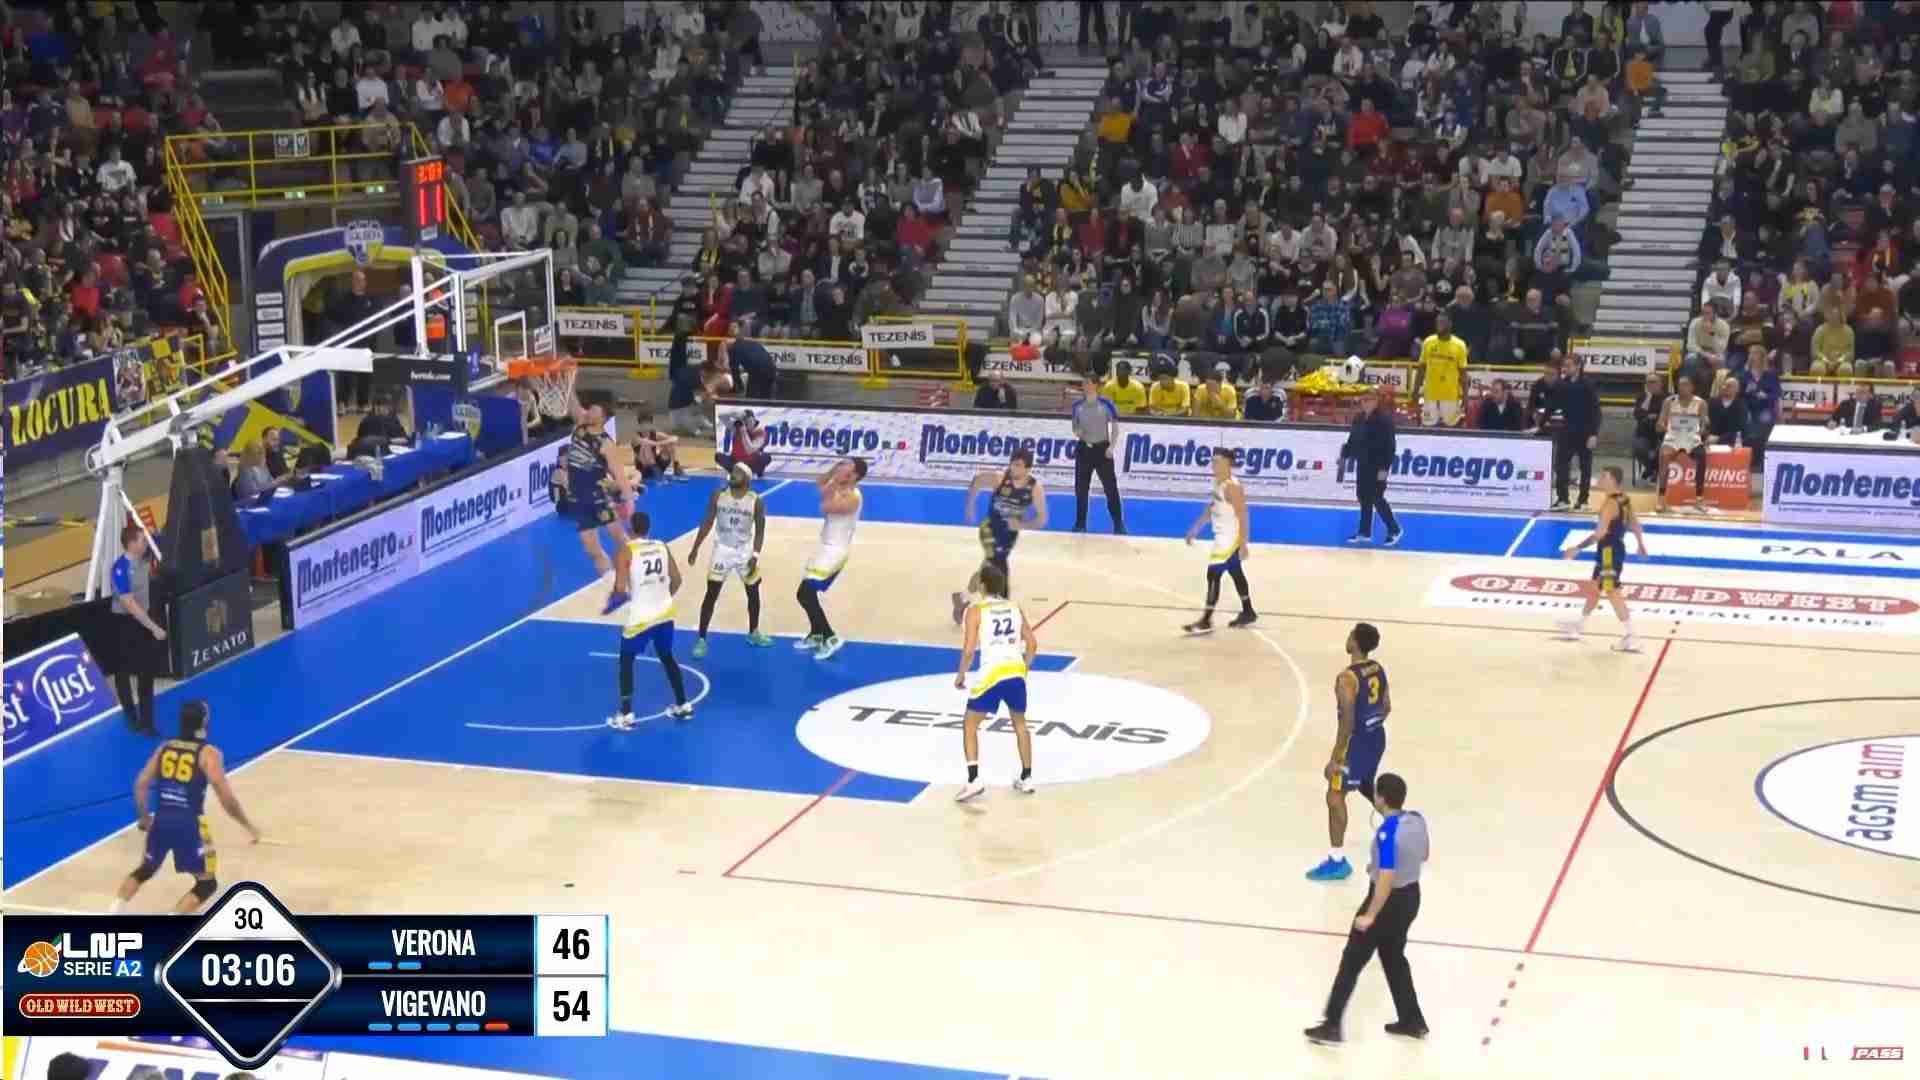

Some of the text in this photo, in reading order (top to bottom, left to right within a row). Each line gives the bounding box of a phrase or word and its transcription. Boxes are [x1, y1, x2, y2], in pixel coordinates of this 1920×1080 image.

[9, 377, 113, 447] LOCURA
[1123, 433, 1294, 474] Monteegro
[297, 484, 508, 609] Montenegro Montenegro
[643, 558, 663, 576] 20
[1471, 576, 1581, 594] OLD
[1739, 591, 1901, 613] WEST
[992, 617, 1015, 636] 22
[191, 631, 248, 667] ZENATO
[41, 663, 96, 725] Just
[1368, 675, 1380, 704] 3
[161, 750, 194, 783] 66
